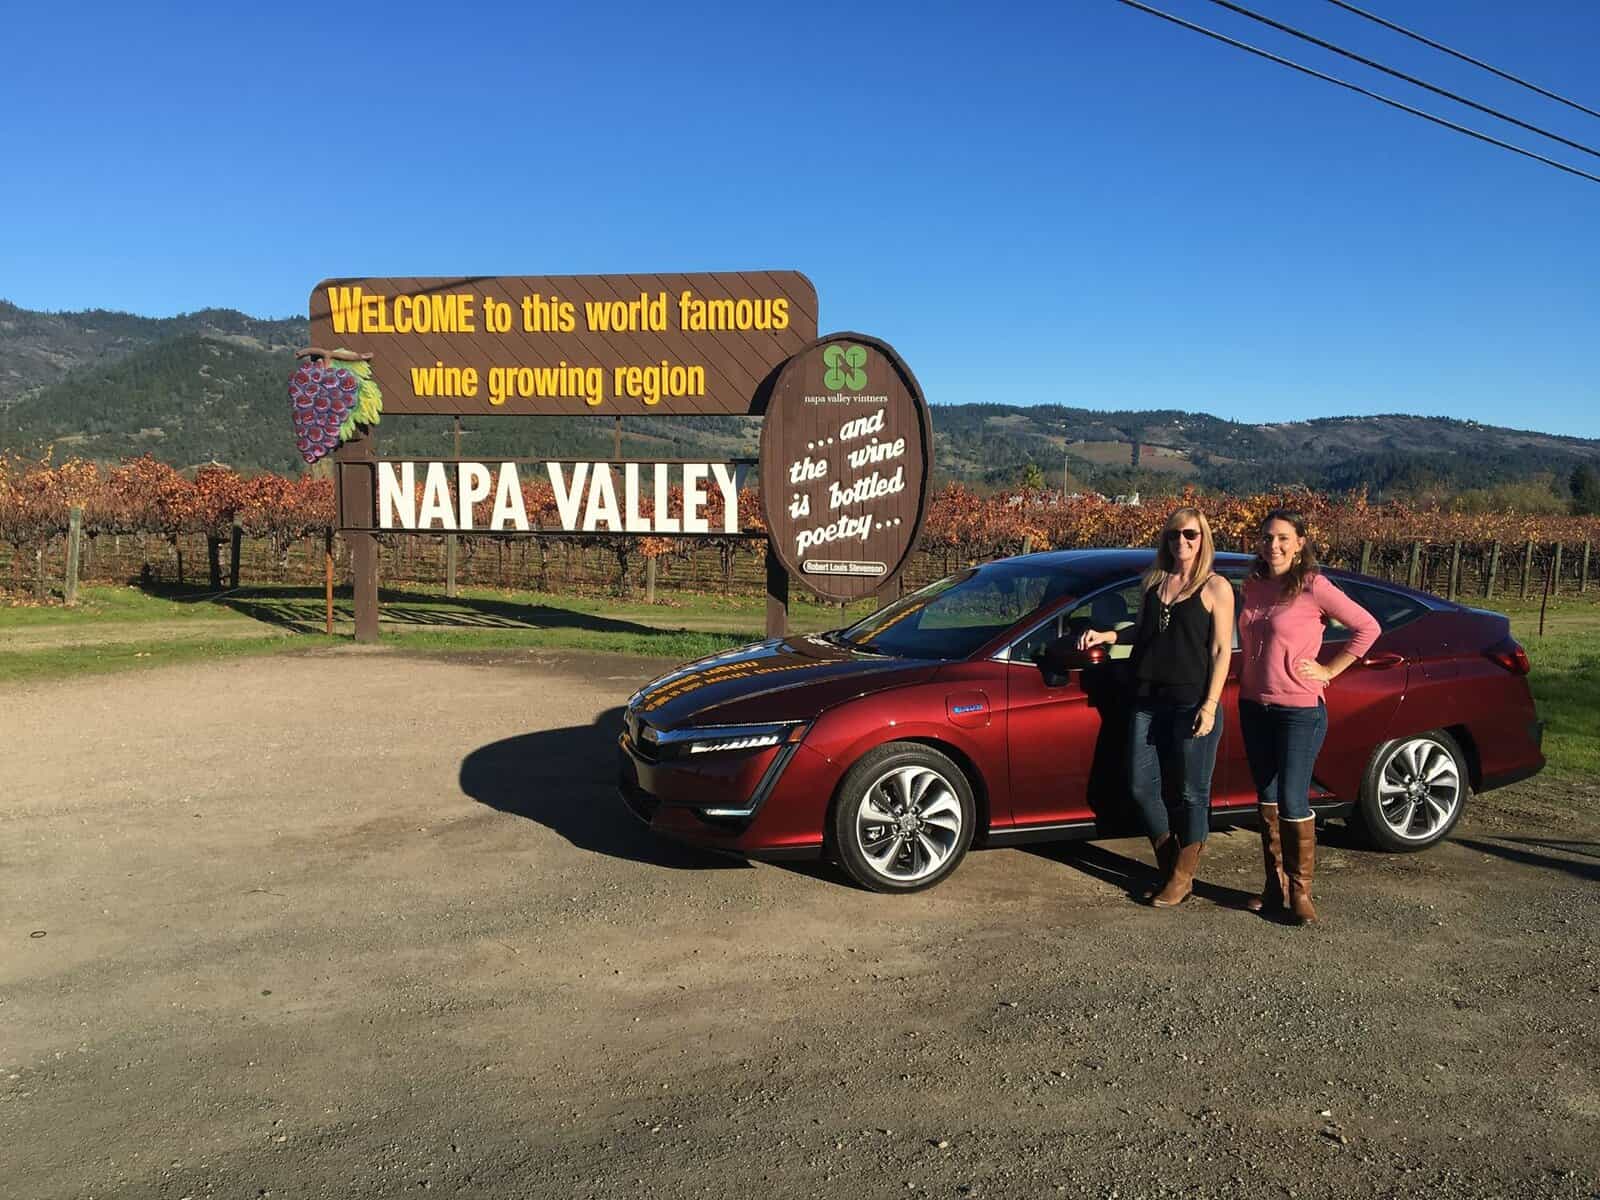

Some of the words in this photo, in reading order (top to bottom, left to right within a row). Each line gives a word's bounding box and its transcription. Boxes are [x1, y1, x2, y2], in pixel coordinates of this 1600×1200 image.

[327, 286, 475, 333] WELCOME
[483, 296, 512, 333] to
[521, 293, 576, 332] this
[585, 292, 667, 332] world
[678, 290, 789, 331] famous
[411, 361, 478, 397] wine
[488, 361, 603, 406] growing
[614, 360, 705, 405] region
[804, 394, 826, 405] napa
[826, 392, 851, 405] valley
[789, 456, 827, 484] the
[847, 437, 905, 469] wine
[378, 462, 530, 531] NAPA
[546, 462, 740, 534] VALLEY
[788, 493, 810, 519] is
[828, 466, 905, 509] bottled
